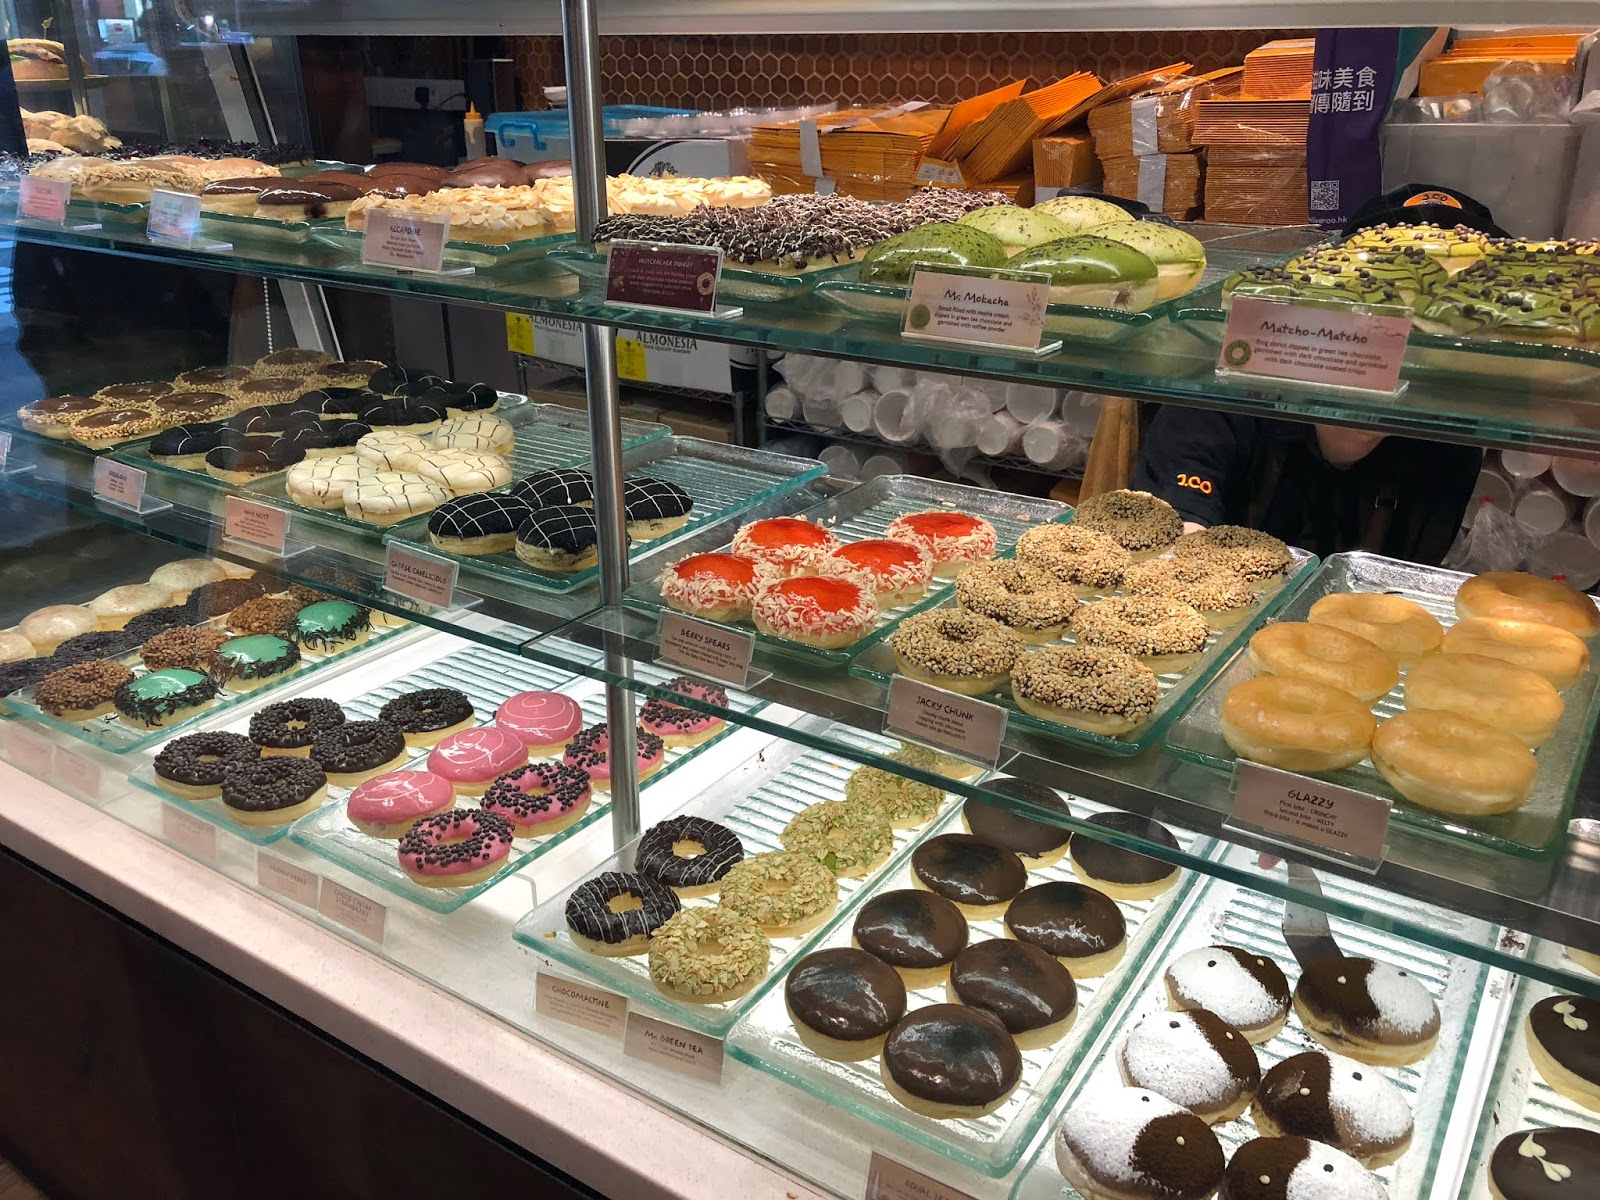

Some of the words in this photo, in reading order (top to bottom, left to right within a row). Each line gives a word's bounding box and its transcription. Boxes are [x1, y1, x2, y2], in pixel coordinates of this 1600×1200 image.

[944, 290, 961, 301] Mr.
[964, 292, 1010, 306] Mokacha
[528, 315, 583, 333] ALMONESIA
[1260, 320, 1369, 346] Matcho-Matcho
[636, 330, 698, 350] ALMONESIA
[1288, 343, 1310, 352] dipped
[1318, 348, 1336, 356] green
[1294, 360, 1324, 370] chocolate
[1313, 354, 1344, 364] chocolate
[681, 628, 703, 642] BERRY
[705, 636, 731, 651] SPEARS
[916, 696, 942, 711] JACKY
[943, 704, 975, 722] CHUNK
[1287, 789, 1334, 810] GLAZZY
[1279, 807, 1299, 817] Second
[1300, 813, 1311, 821] bite
[1317, 818, 1334, 827] MELTY
[1280, 800, 1292, 808] First
[1310, 809, 1337, 821] CRUNCHY
[1263, 810, 1278, 818] Third
[1301, 821, 1319, 830] makes
[1325, 828, 1348, 839] GLAZZY
[552, 985, 610, 1009] CHOCOMALTINE
[660, 1034, 686, 1049] GREEN
[689, 1043, 703, 1055] TEA
